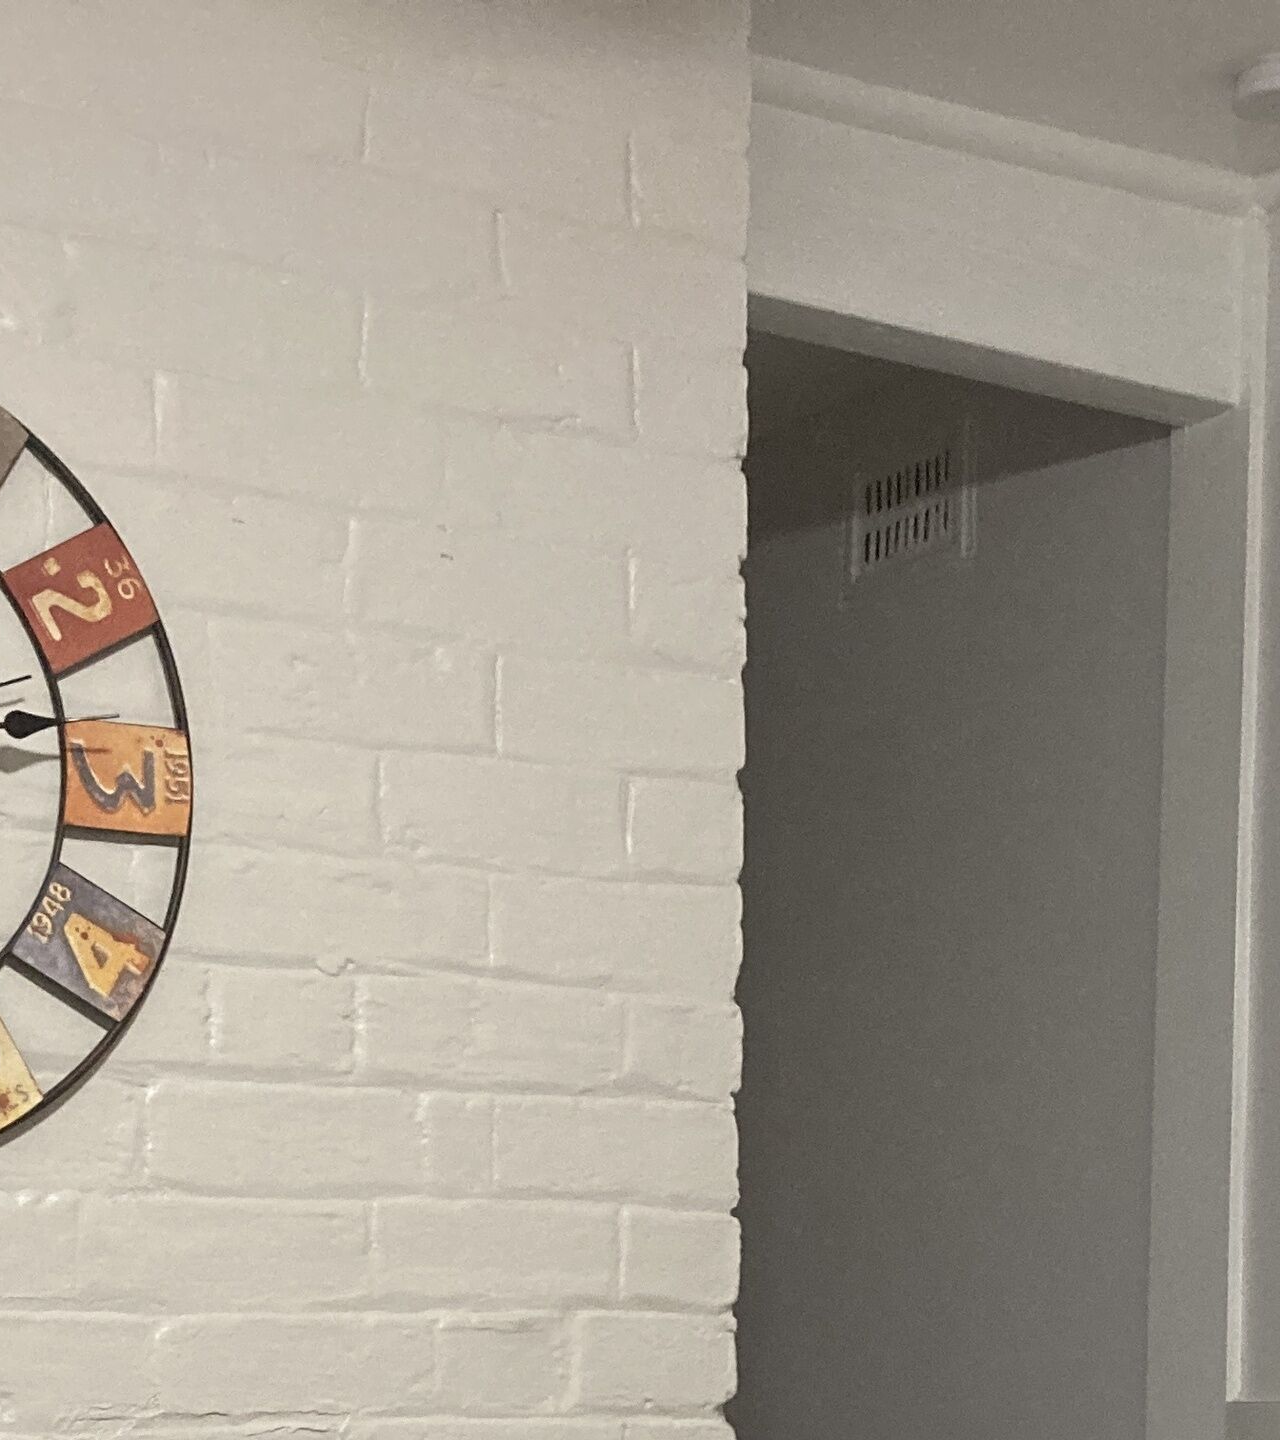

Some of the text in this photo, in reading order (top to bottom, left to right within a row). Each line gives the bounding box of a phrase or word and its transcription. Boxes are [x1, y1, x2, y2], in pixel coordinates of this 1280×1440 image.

[32, 570, 113, 641] 2
[104, 555, 141, 600] 36
[68, 742, 156, 816] 3
[26, 881, 72, 944] 1948
[64, 913, 150, 998] 4
